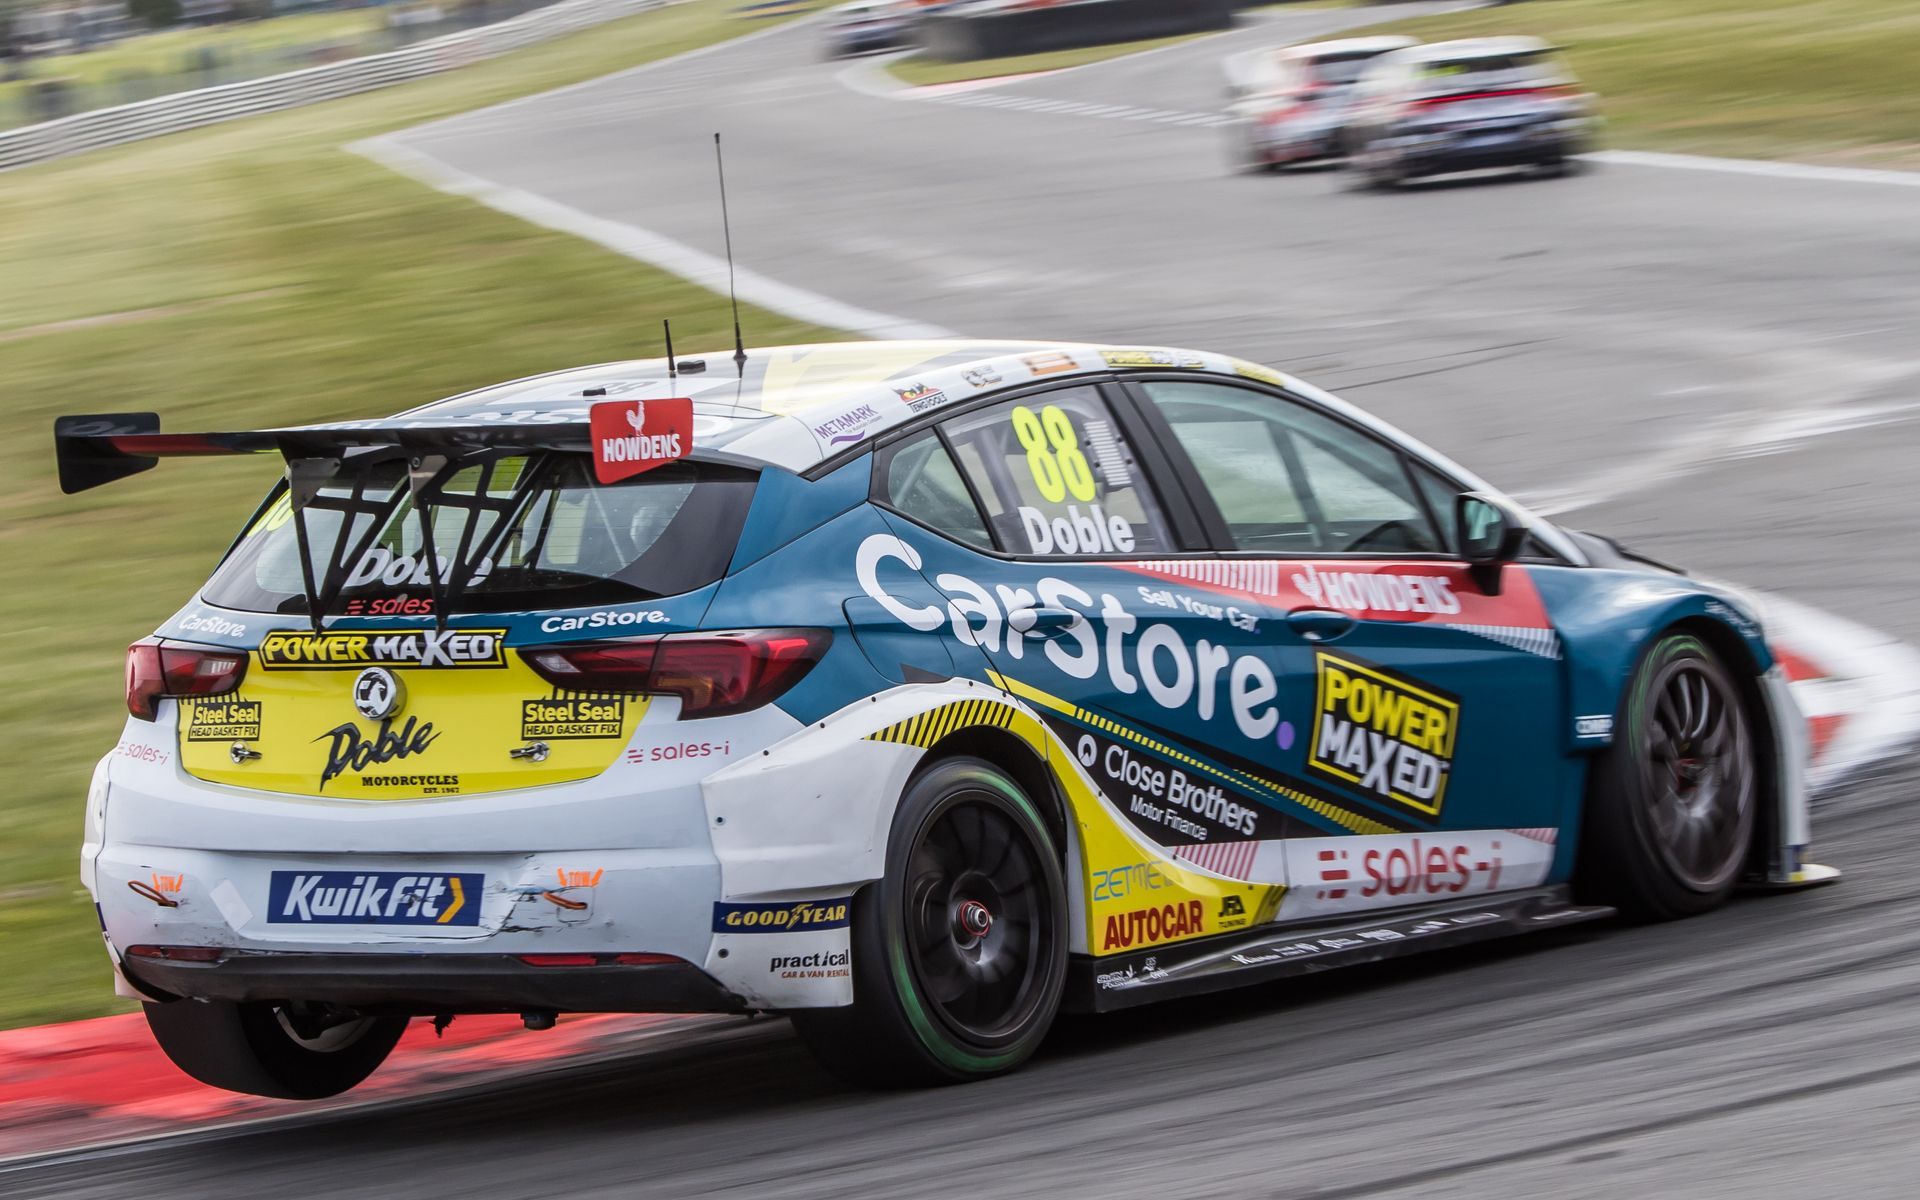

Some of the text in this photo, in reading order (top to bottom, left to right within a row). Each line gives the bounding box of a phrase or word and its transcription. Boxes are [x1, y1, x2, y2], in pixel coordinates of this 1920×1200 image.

[814, 403, 879, 439] METAMARK
[602, 433, 682, 463] HOWDENS
[1011, 405, 1096, 502] 88
[1018, 504, 1136, 554] Doble
[1137, 586, 1178, 609] Sell
[1175, 594, 1223, 620] Your
[1317, 571, 1462, 615] HOWDENS
[541, 610, 671, 632] CarStore.
[264, 629, 495, 666] POWER MAXED
[855, 533, 1296, 751] CarStore.
[193, 704, 259, 724] Steel Seal
[524, 701, 621, 722] Steel Seal
[1324, 666, 1447, 755] POWER
[190, 725, 257, 737] HEAD GASKET FIX
[526, 723, 618, 735] HEAD GASKET FIX
[309, 715, 442, 792] Doble
[651, 740, 730, 762] sales-i
[1317, 713, 1442, 799] MAXED
[362, 775, 459, 787] MOTORCYCLES
[1105, 744, 1259, 836] Close Brothers
[1130, 794, 1208, 841] Motor Finance
[1104, 900, 1203, 950] AUTOCAR
[770, 949, 849, 972] practical
[782, 971, 797, 979] CAR
[807, 970, 824, 978] VAN
